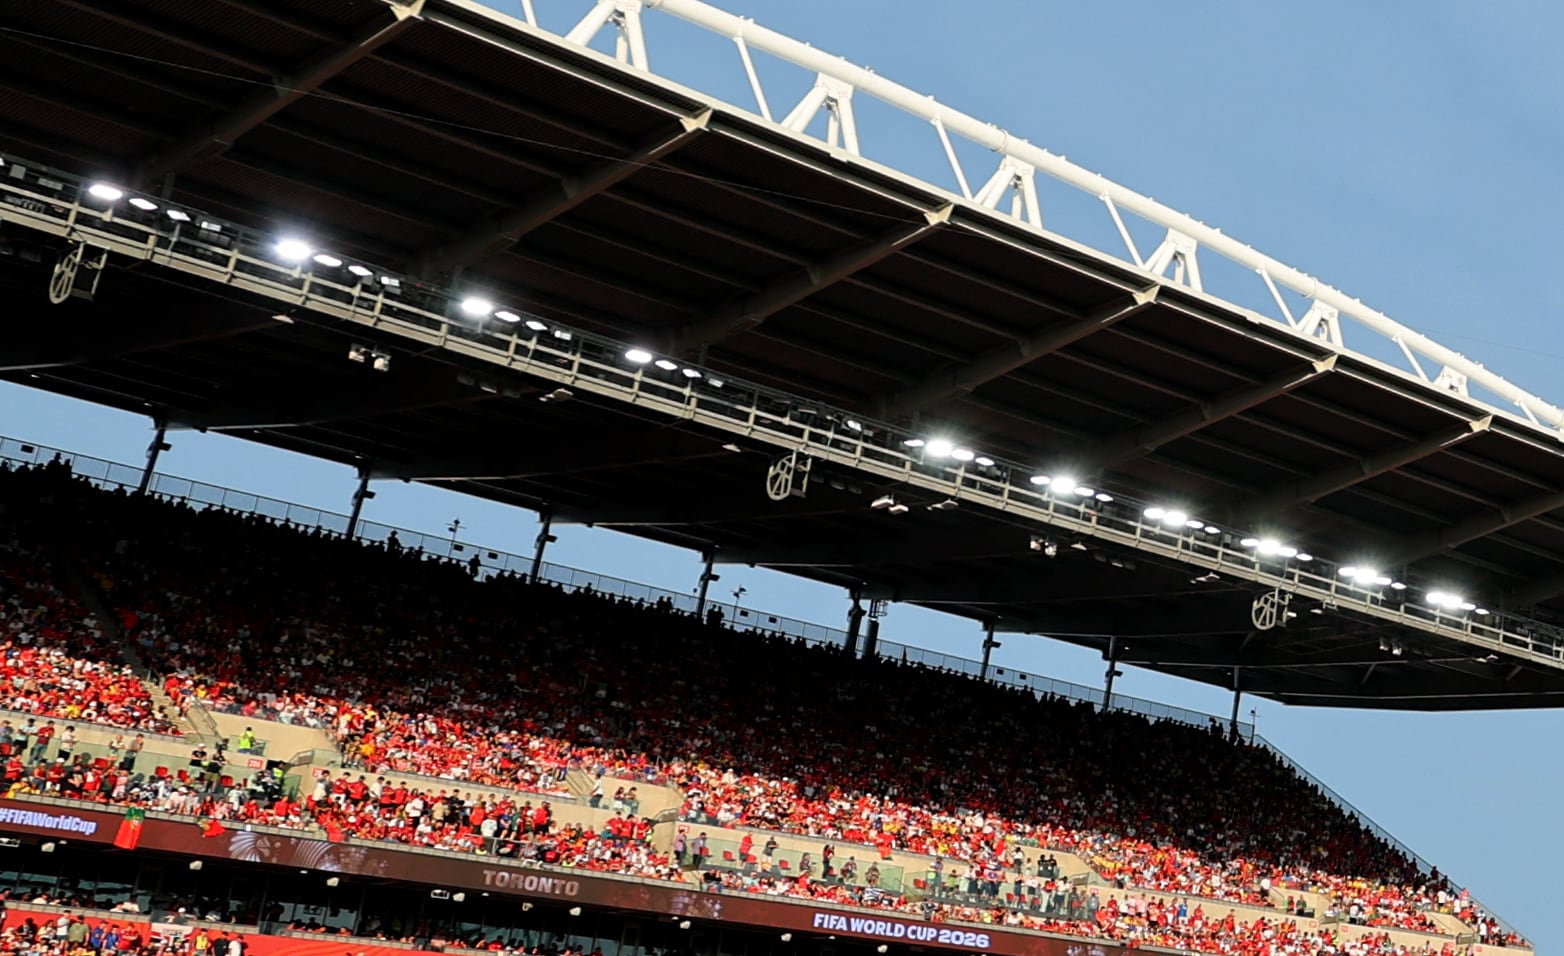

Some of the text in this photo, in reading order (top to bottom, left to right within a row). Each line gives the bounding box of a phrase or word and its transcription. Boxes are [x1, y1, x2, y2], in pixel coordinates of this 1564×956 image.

[0, 808, 97, 836] #FIFAWorldCup
[483, 869, 579, 896] TORONTO
[813, 913, 990, 948] FIFA WORLD CUP 2026
